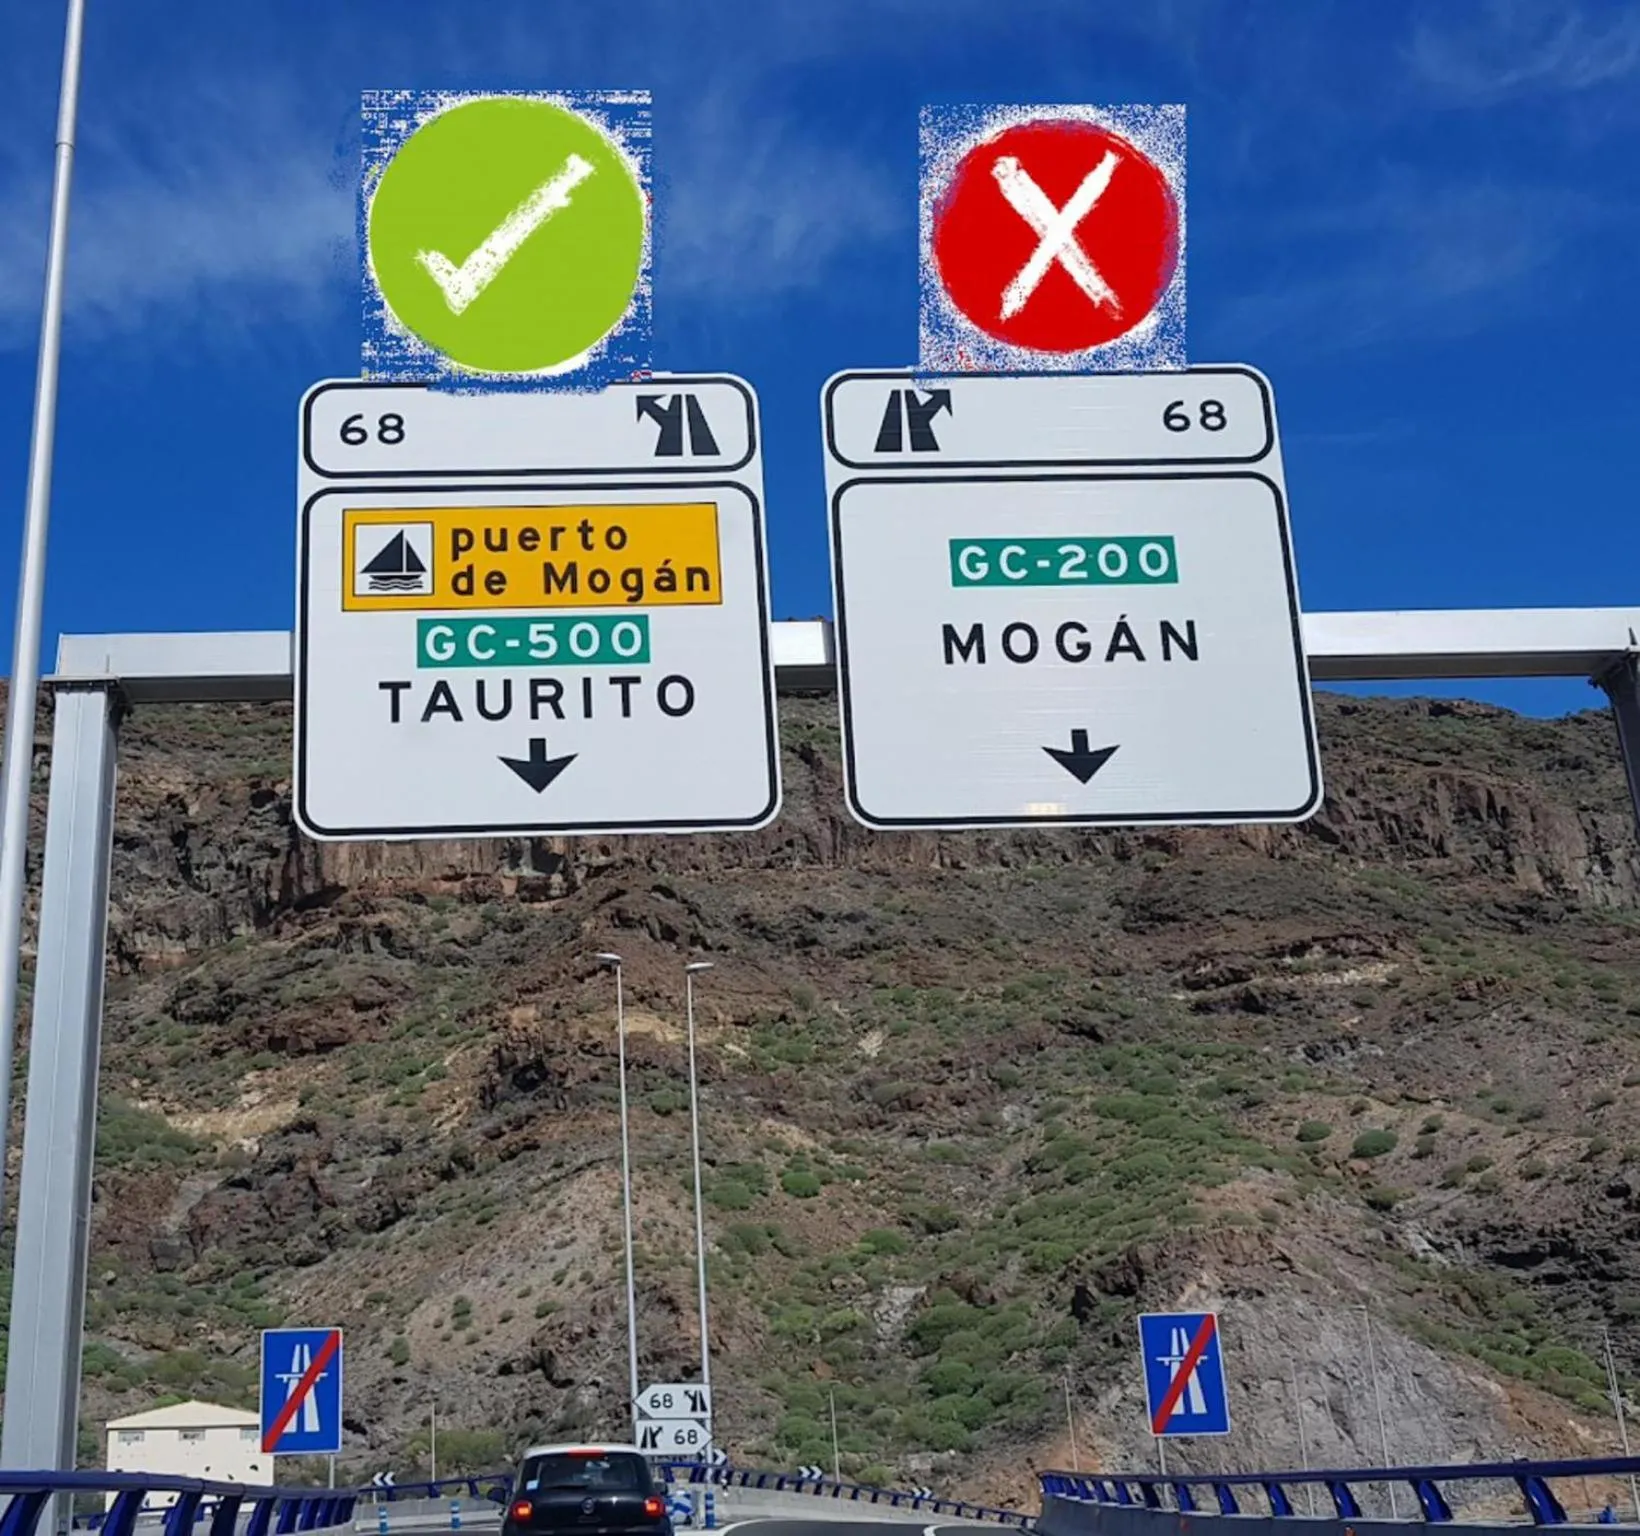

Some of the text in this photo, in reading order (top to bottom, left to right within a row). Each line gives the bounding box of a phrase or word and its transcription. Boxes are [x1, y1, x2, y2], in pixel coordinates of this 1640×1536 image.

[339, 412, 406, 446] 68
[1162, 399, 1228, 432] 68
[451, 518, 629, 562] puerto
[450, 558, 711, 603] de Mogán
[957, 541, 1170, 580] GC-200
[424, 620, 643, 661] GC-500
[941, 613, 1200, 665] MOGÁN
[378, 674, 695, 724] TAURITO
[651, 1393, 673, 1408] 68
[675, 1429, 698, 1445] 68
